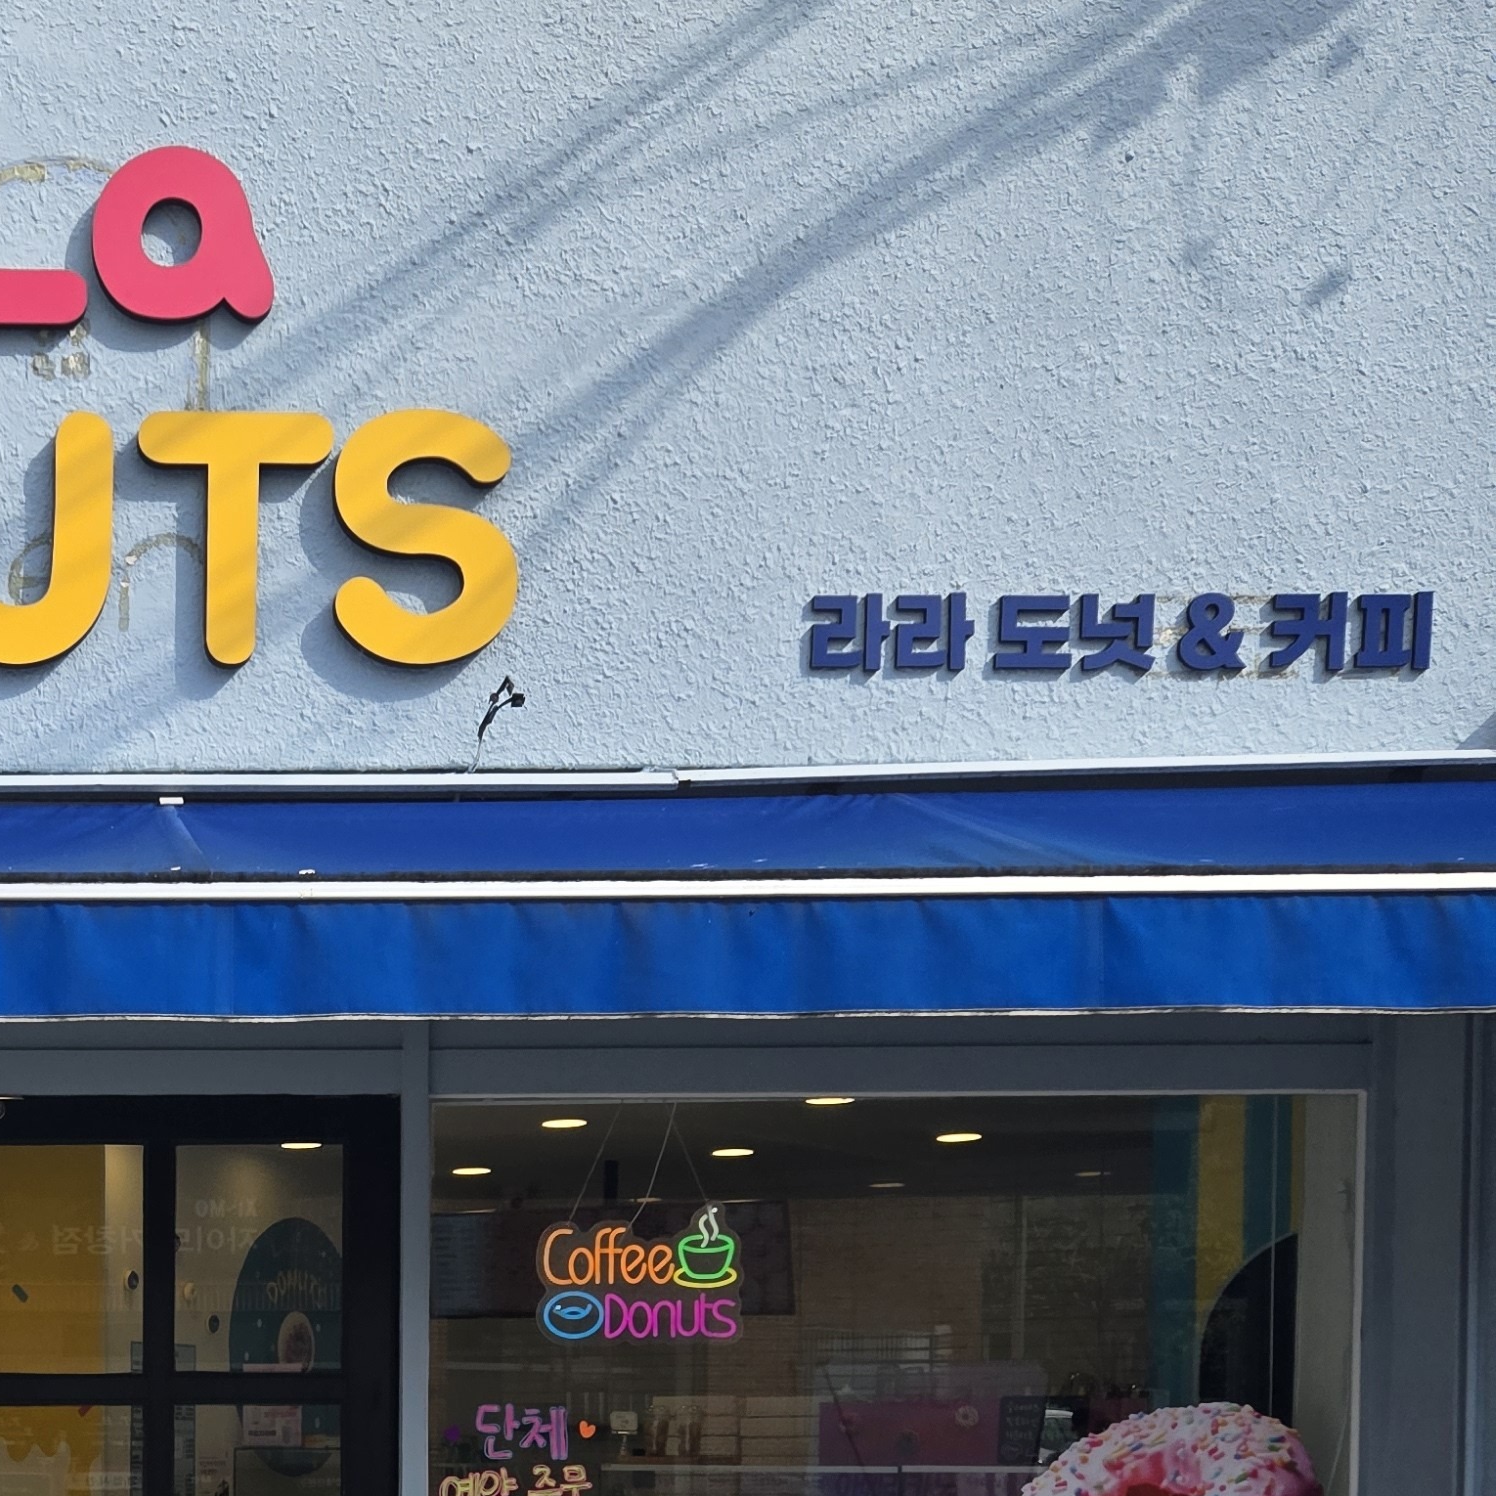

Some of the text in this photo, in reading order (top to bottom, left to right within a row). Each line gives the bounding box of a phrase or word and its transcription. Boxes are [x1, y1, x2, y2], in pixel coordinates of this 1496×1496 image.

[808, 591, 1435, 672] 라라 도넛 & 커피
[542, 1226, 675, 1286] Coffee
[604, 1292, 738, 1339] Donuts
[476, 1403, 569, 1461] 단체
